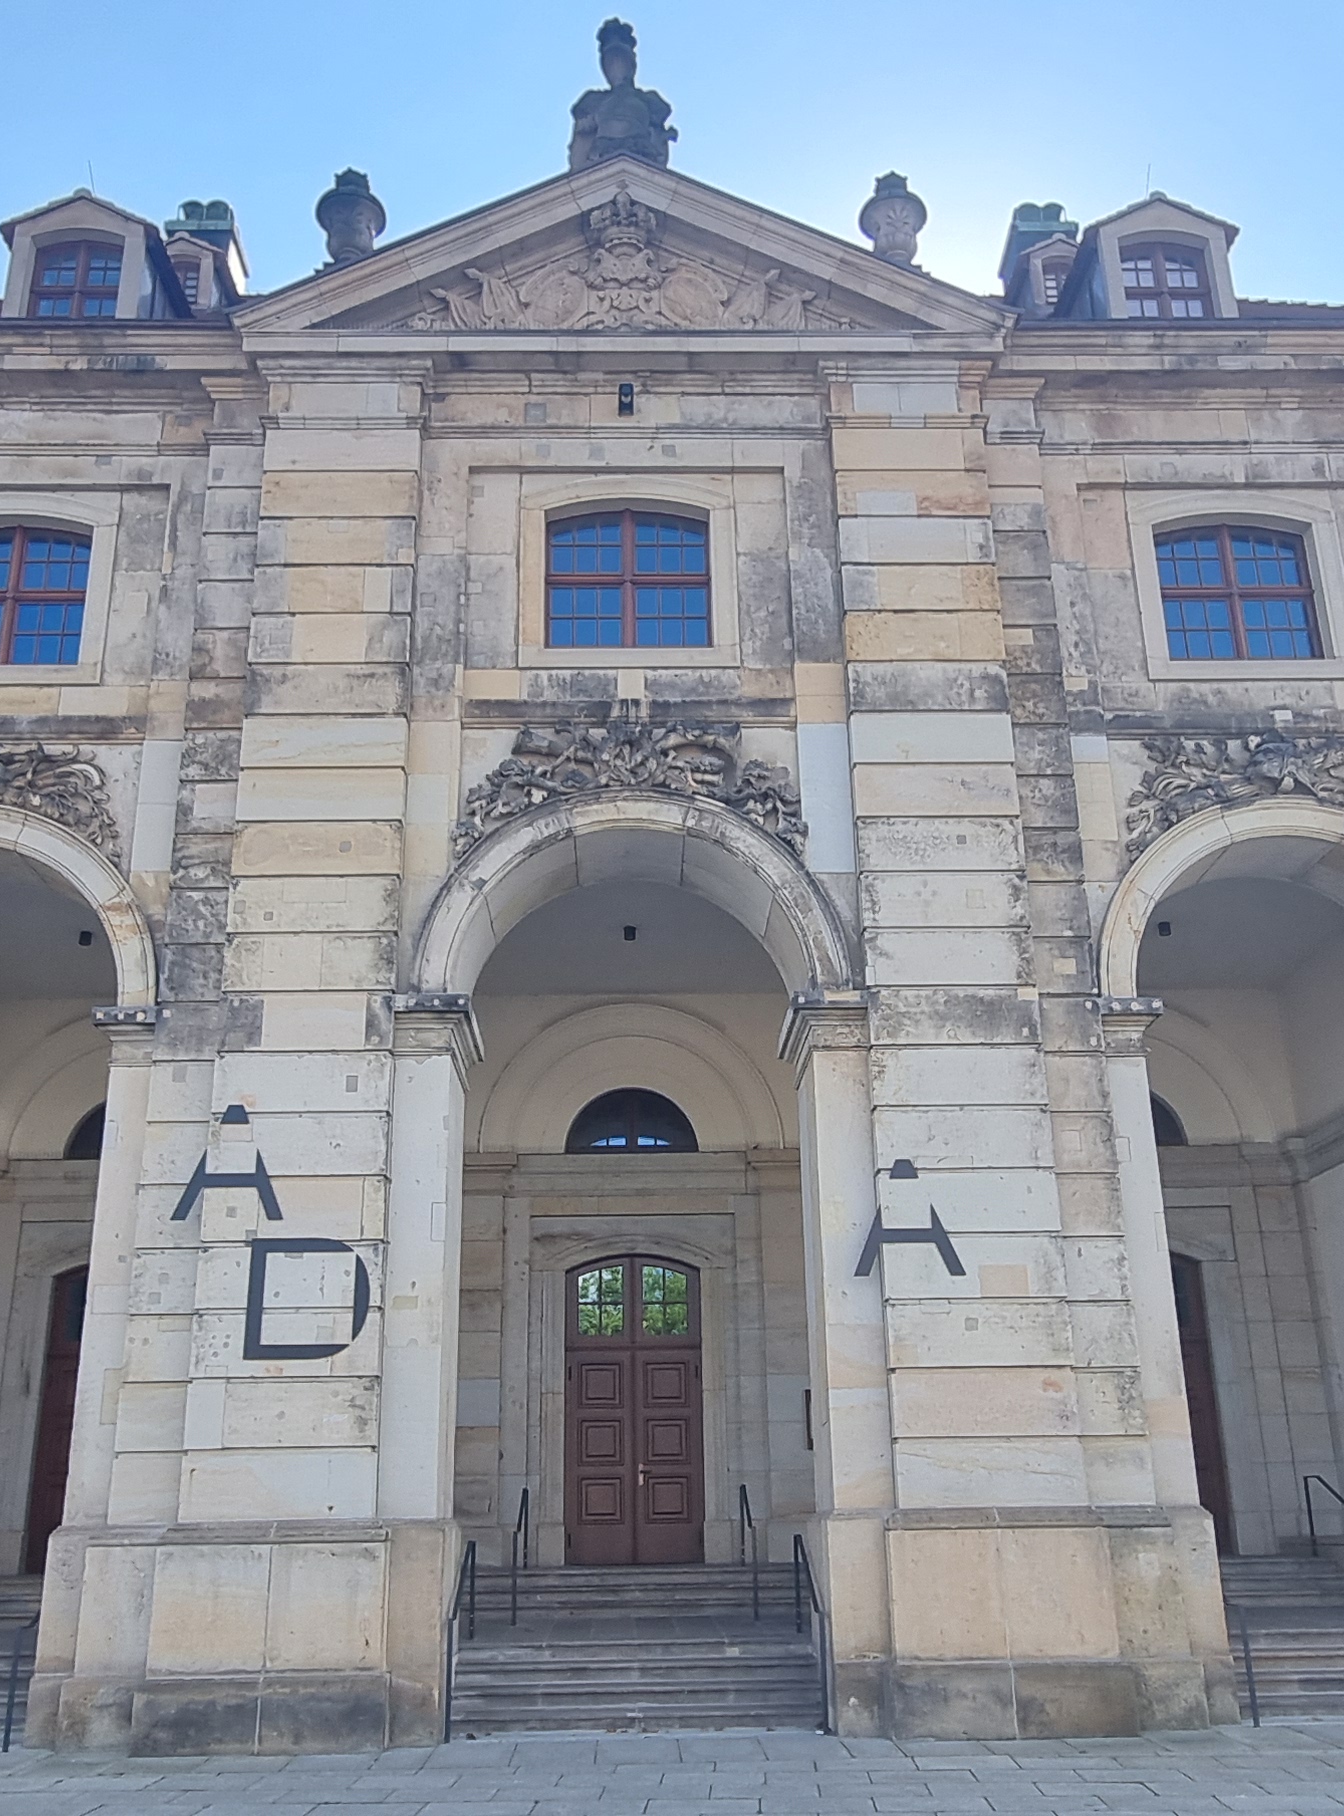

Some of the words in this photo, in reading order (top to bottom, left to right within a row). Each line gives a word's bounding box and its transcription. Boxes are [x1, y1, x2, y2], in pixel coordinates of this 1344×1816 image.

[170, 1104, 284, 1221] A
[853, 1158, 967, 1277] A
[243, 1237, 371, 1360] D
